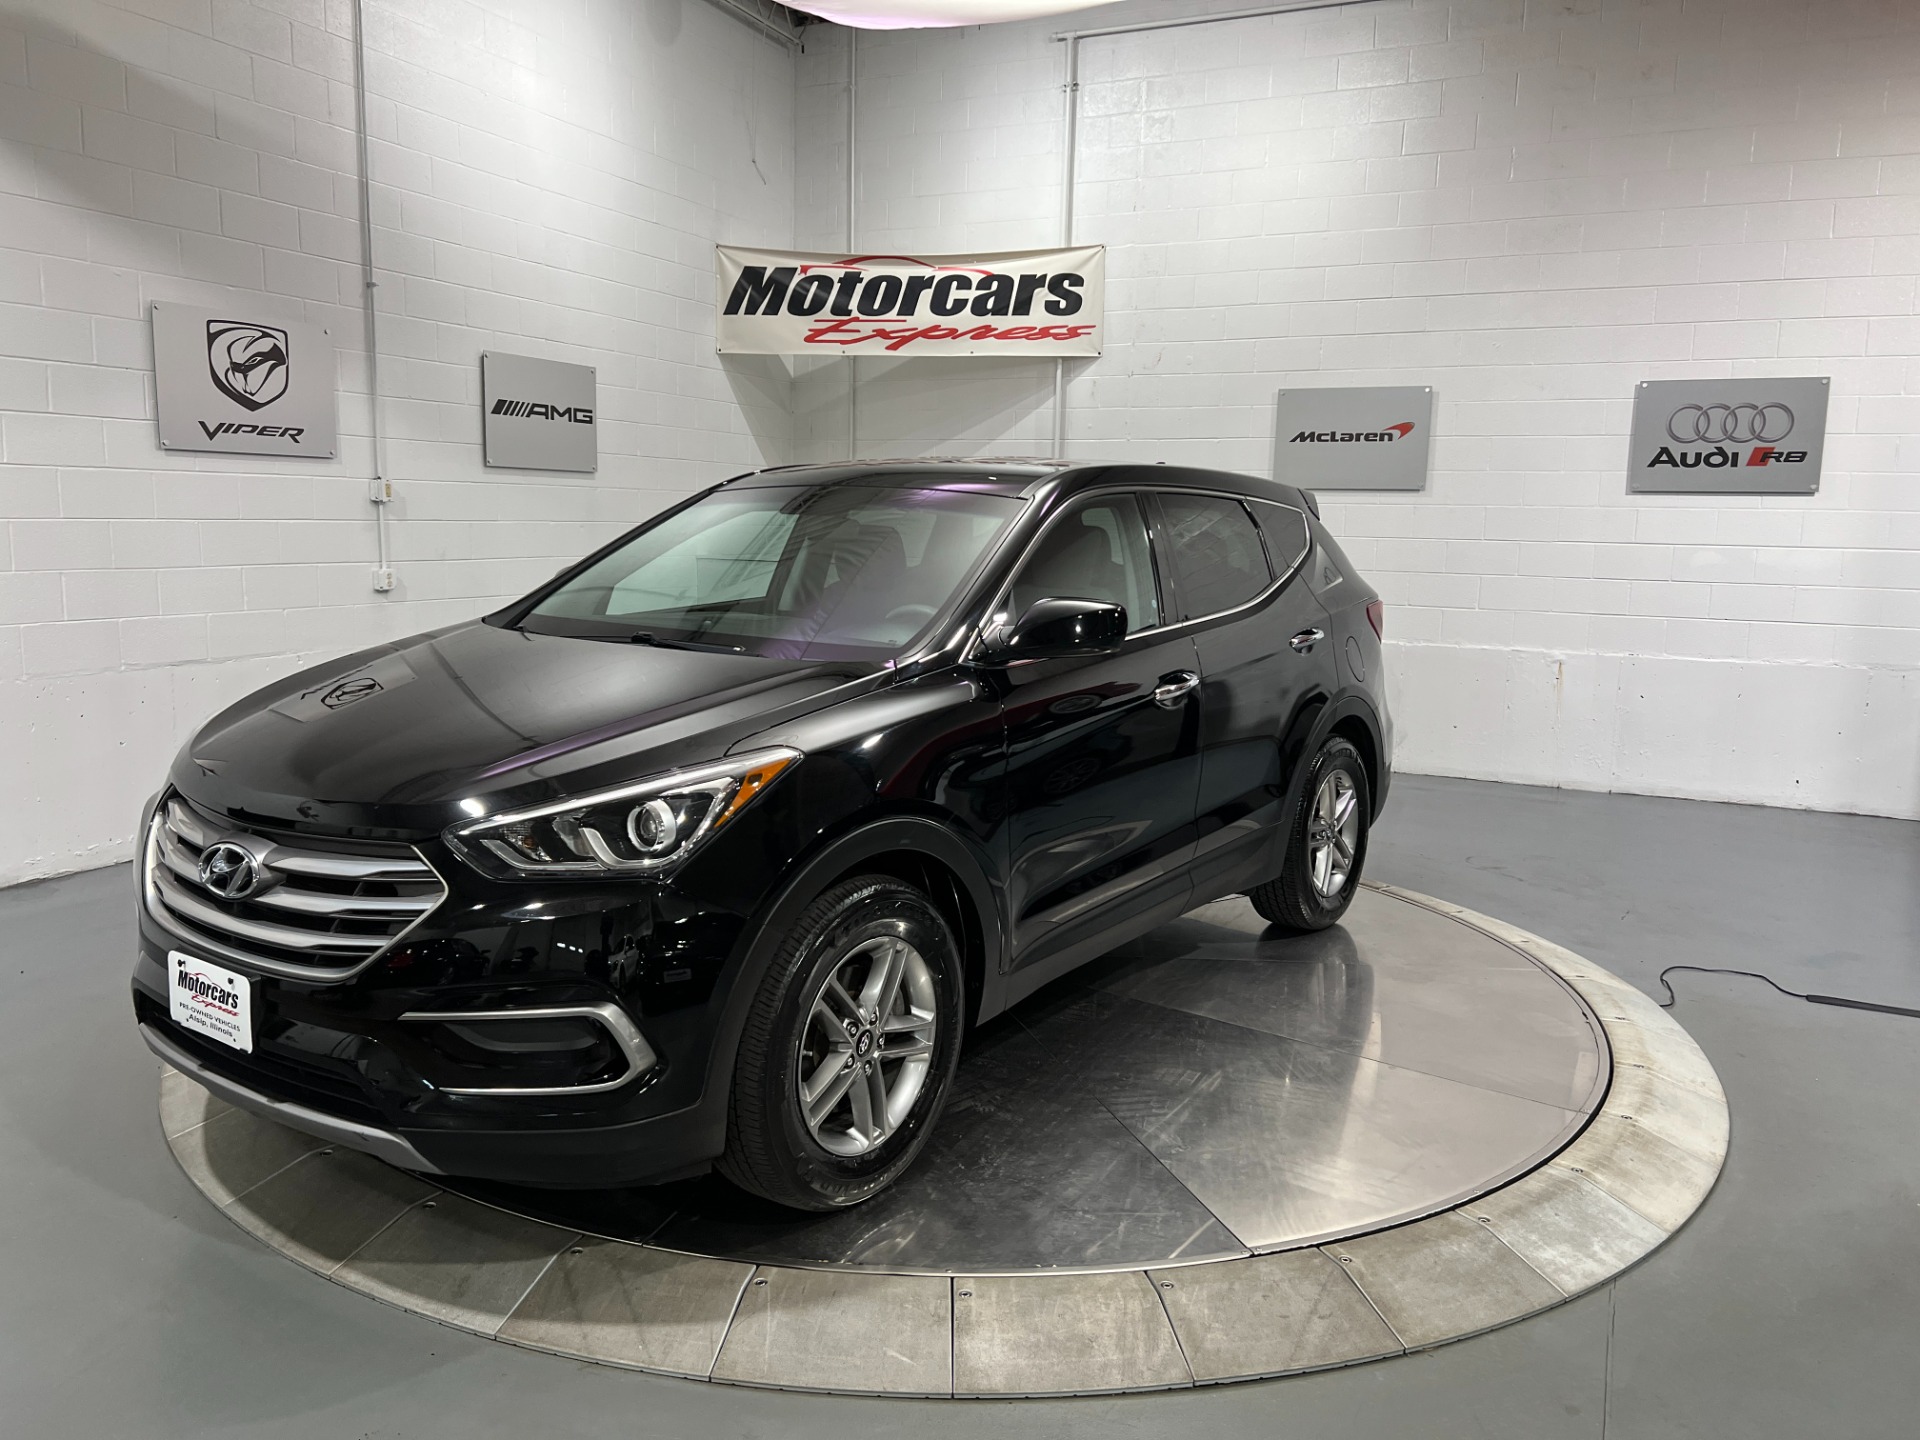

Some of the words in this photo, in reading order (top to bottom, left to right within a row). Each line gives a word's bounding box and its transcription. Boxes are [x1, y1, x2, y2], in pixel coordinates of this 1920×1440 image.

[723, 266, 1085, 317] Motorcars
[803, 317, 1096, 351] Express
[526, 403, 593, 424] AMG
[197, 420, 305, 443] VIPER
[1289, 431, 1394, 443] McLaren
[1646, 446, 1738, 469] Audi
[1758, 450, 1808, 464] R8
[178, 970, 239, 1009] Motorcars
[191, 994, 239, 1016] Express
[179, 1002, 214, 1020] PRE-OWNED
[214, 1016, 241, 1032] VEHICLES
[189, 1014, 209, 1027] Alsip,
[210, 1022, 233, 1037] Illinois
